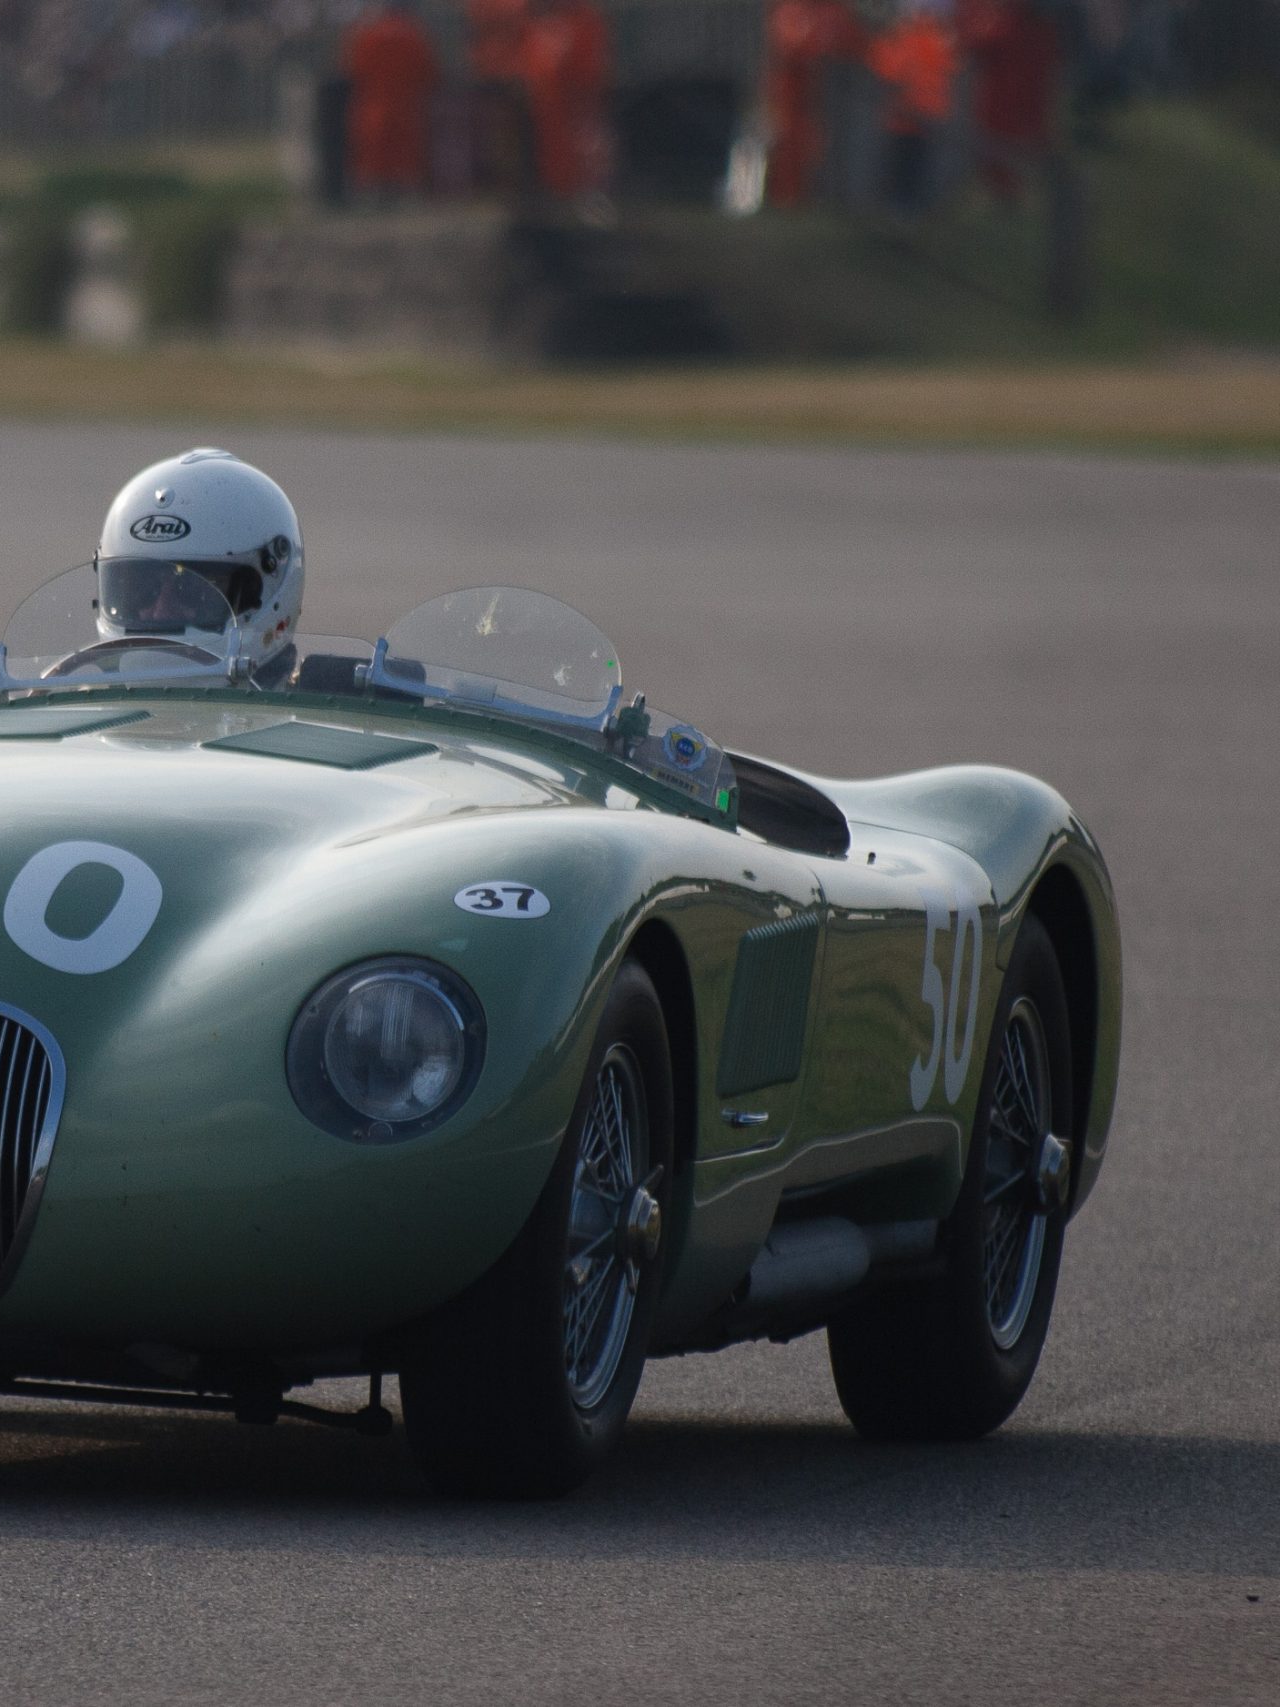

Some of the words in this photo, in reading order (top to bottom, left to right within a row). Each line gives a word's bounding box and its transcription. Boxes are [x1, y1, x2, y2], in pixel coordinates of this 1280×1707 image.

[135, 515, 182, 536] Arai
[465, 887, 535, 912] 37
[910, 887, 983, 1112] 50
